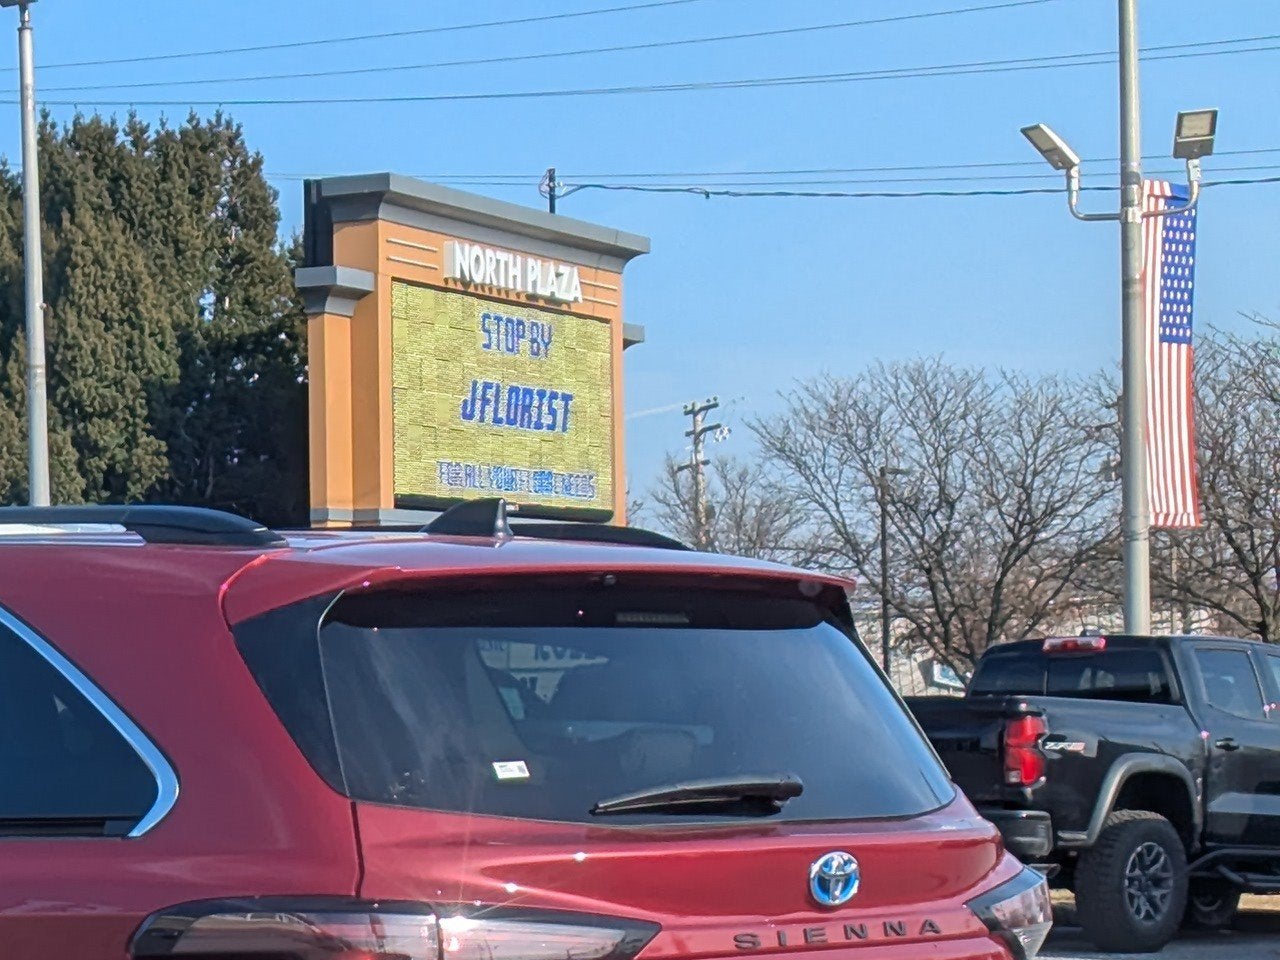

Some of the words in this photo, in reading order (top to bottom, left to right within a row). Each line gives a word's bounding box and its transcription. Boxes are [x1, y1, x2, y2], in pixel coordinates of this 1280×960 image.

[445, 240, 522, 291] NORTH
[526, 257, 583, 303] PLAZA
[481, 312, 526, 353] STOP
[529, 320, 553, 357] BY
[733, 918, 942, 951] SIENNA
